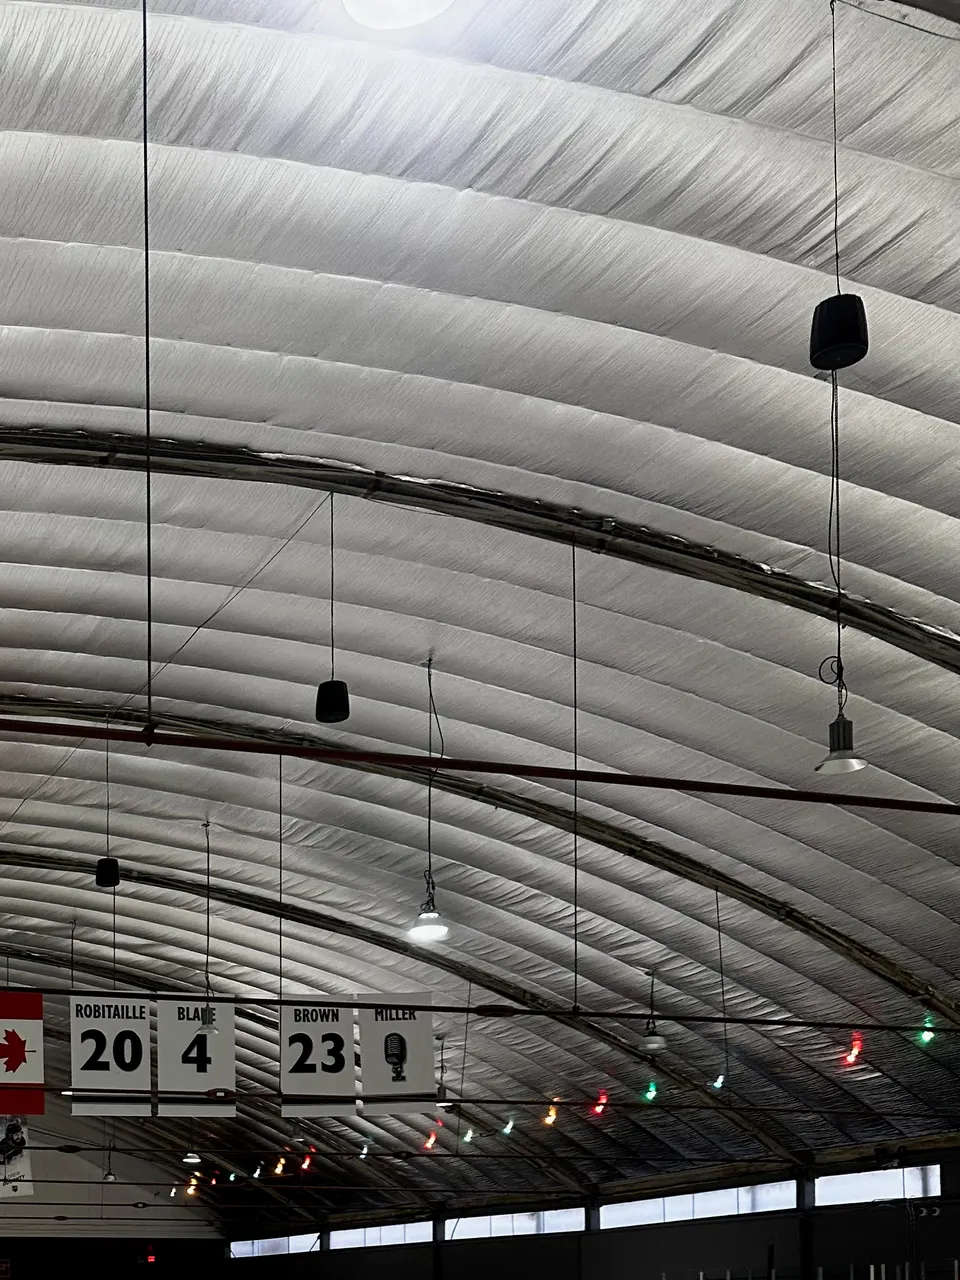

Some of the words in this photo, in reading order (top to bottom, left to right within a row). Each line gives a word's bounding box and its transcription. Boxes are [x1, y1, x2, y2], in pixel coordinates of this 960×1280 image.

[75, 1004, 146, 1019] ROBITAILLE
[178, 1007, 216, 1021] BLAE
[294, 1008, 339, 1022] BROWN
[375, 1008, 416, 1021] MILLER
[80, 1029, 142, 1072] 20
[182, 1034, 211, 1073] 4
[288, 1033, 345, 1073] 23
